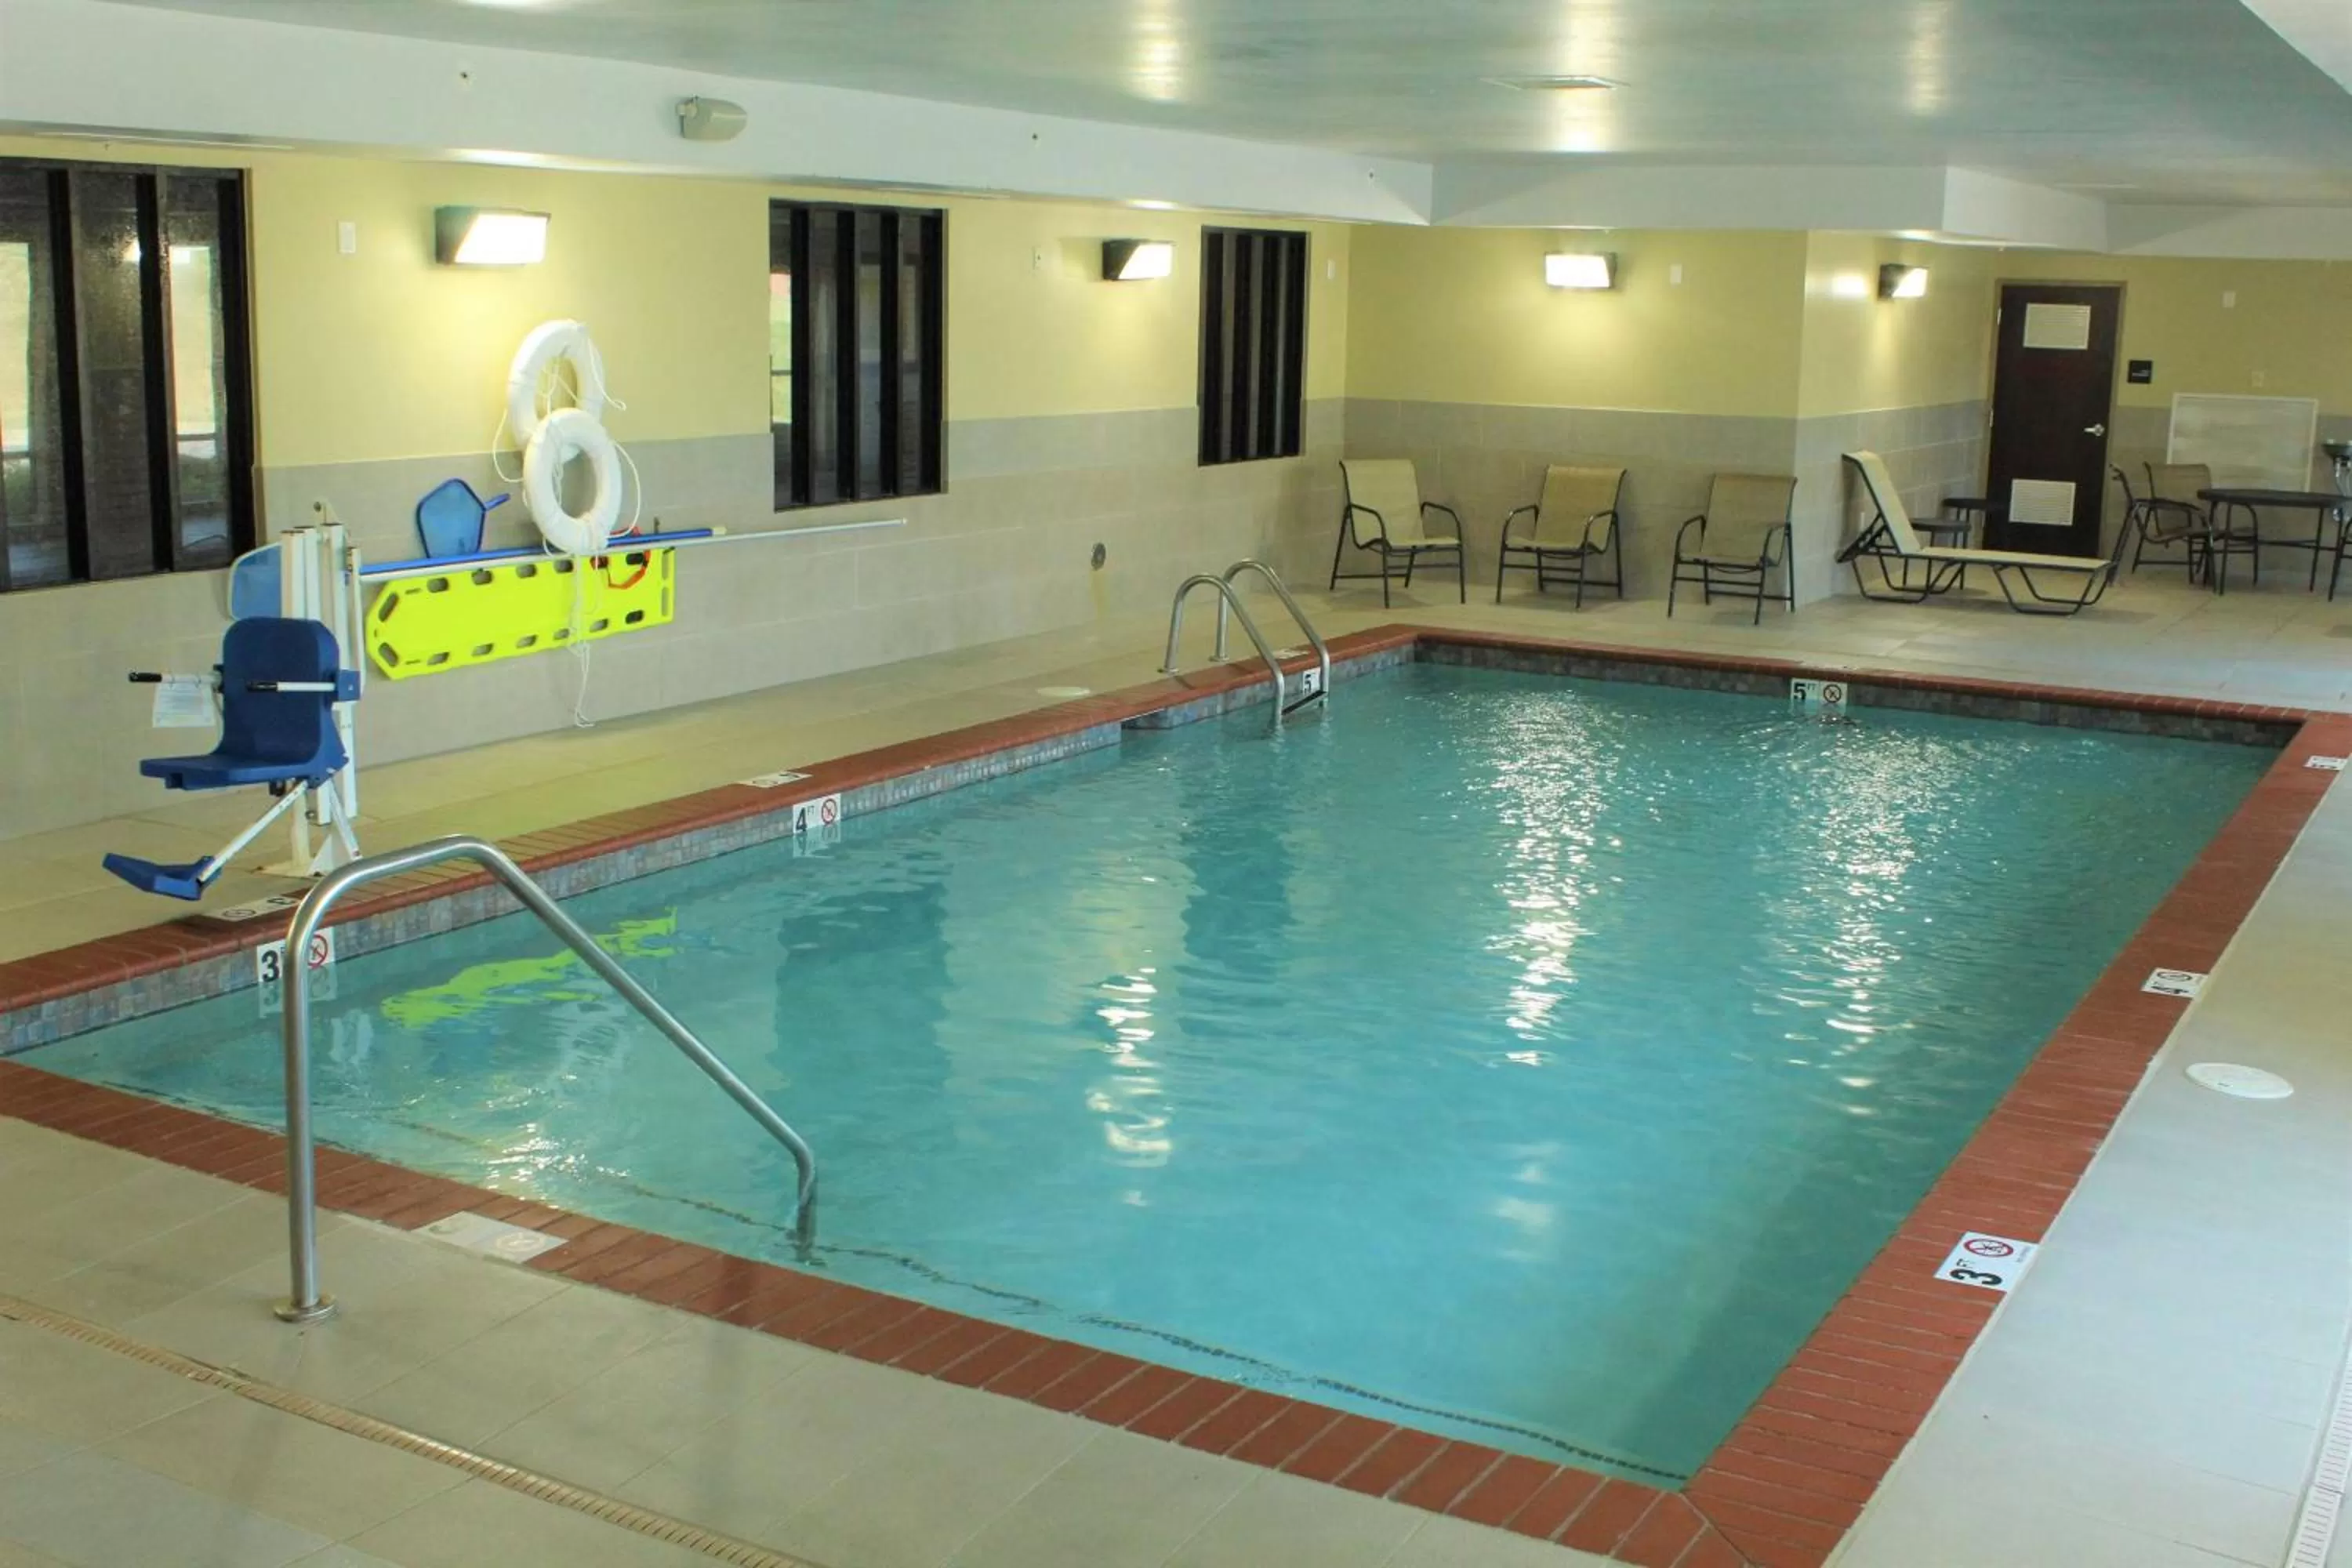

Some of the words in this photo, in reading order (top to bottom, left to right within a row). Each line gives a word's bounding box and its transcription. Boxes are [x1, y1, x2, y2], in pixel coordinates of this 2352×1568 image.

[1305, 673, 1312, 694] 5
[1794, 683, 1806, 700] 5
[796, 806, 807, 831] 4
[261, 950, 280, 982] 3
[1949, 1269, 2002, 1285] 3
